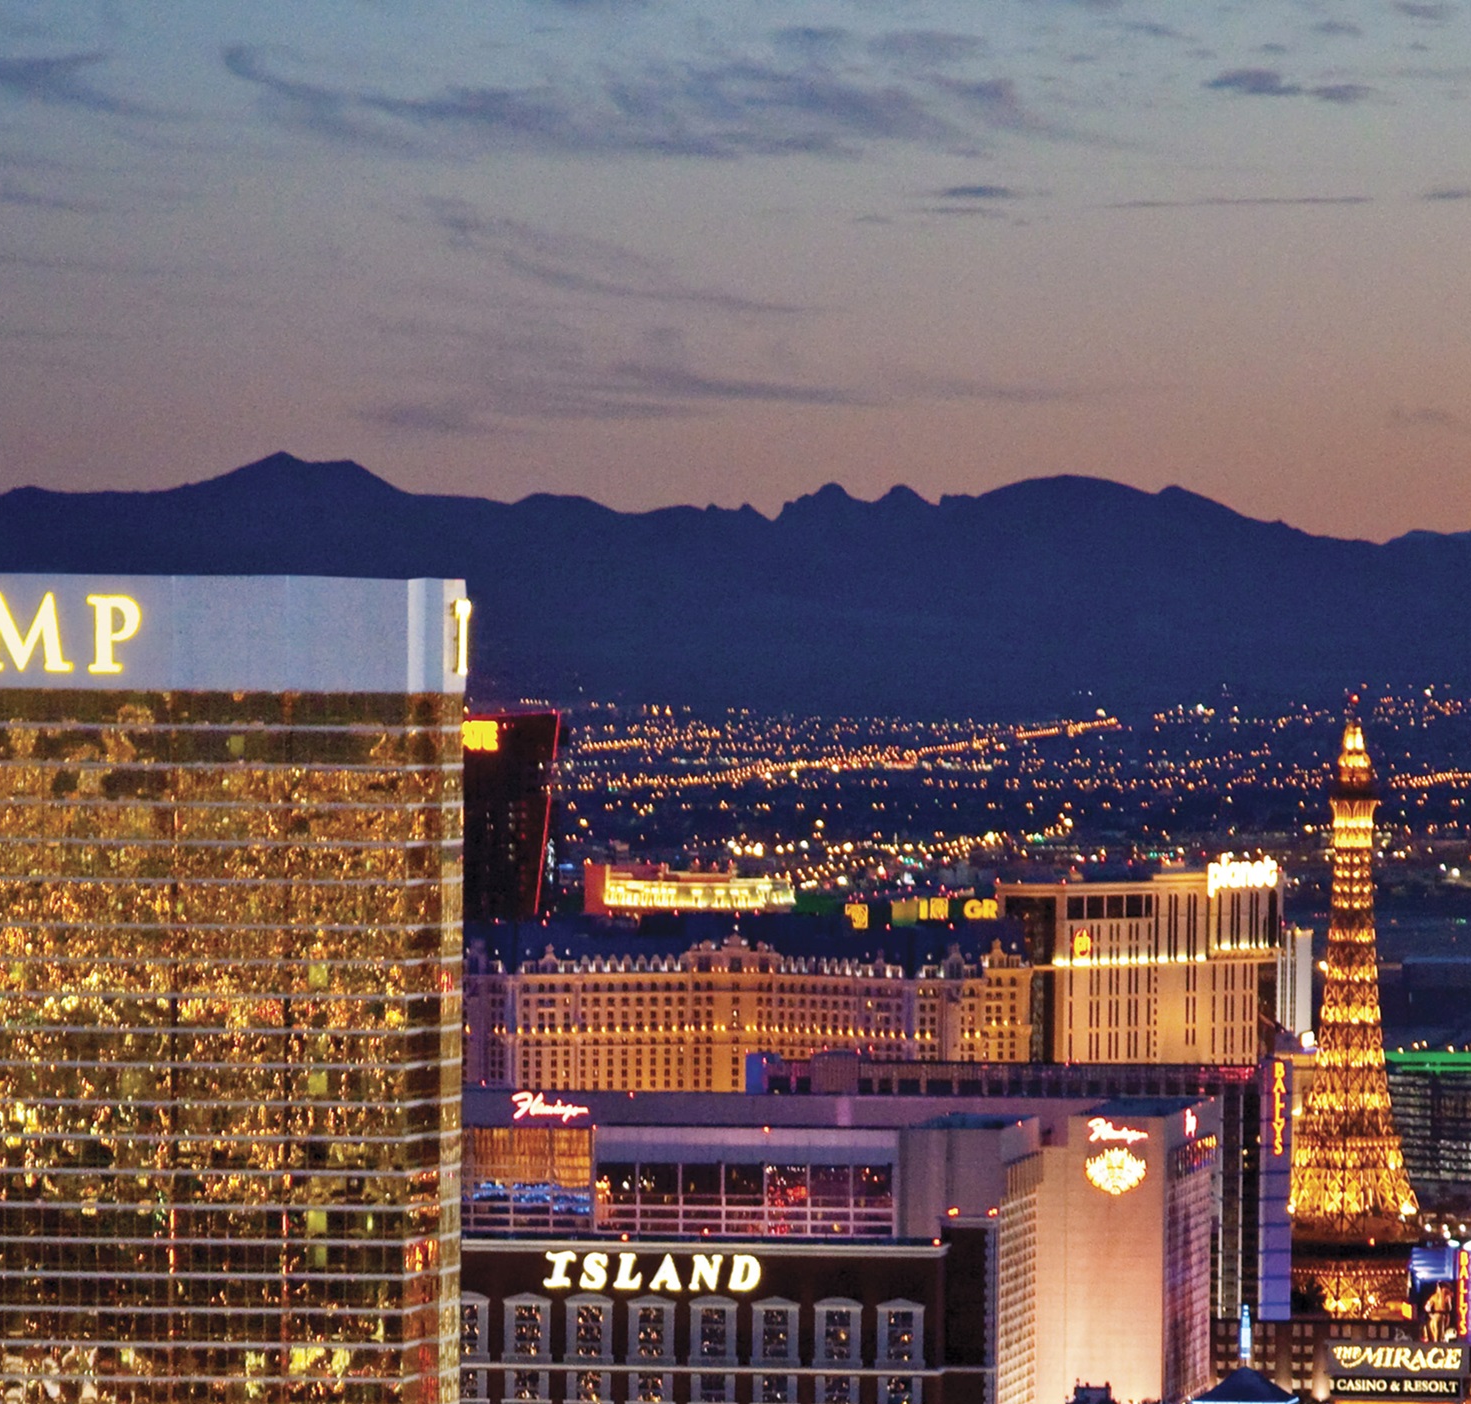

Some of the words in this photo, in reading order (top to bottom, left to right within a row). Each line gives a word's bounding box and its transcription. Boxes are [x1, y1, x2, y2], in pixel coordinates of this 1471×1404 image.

[542, 1250, 762, 1292] ISLAND
[1333, 1346, 1362, 1362] THE
[1360, 1346, 1462, 1372] MIRAGE
[1336, 1379, 1387, 1391] CASINO
[1390, 1381, 1400, 1392] &
[1403, 1380, 1459, 1393] RESORT
